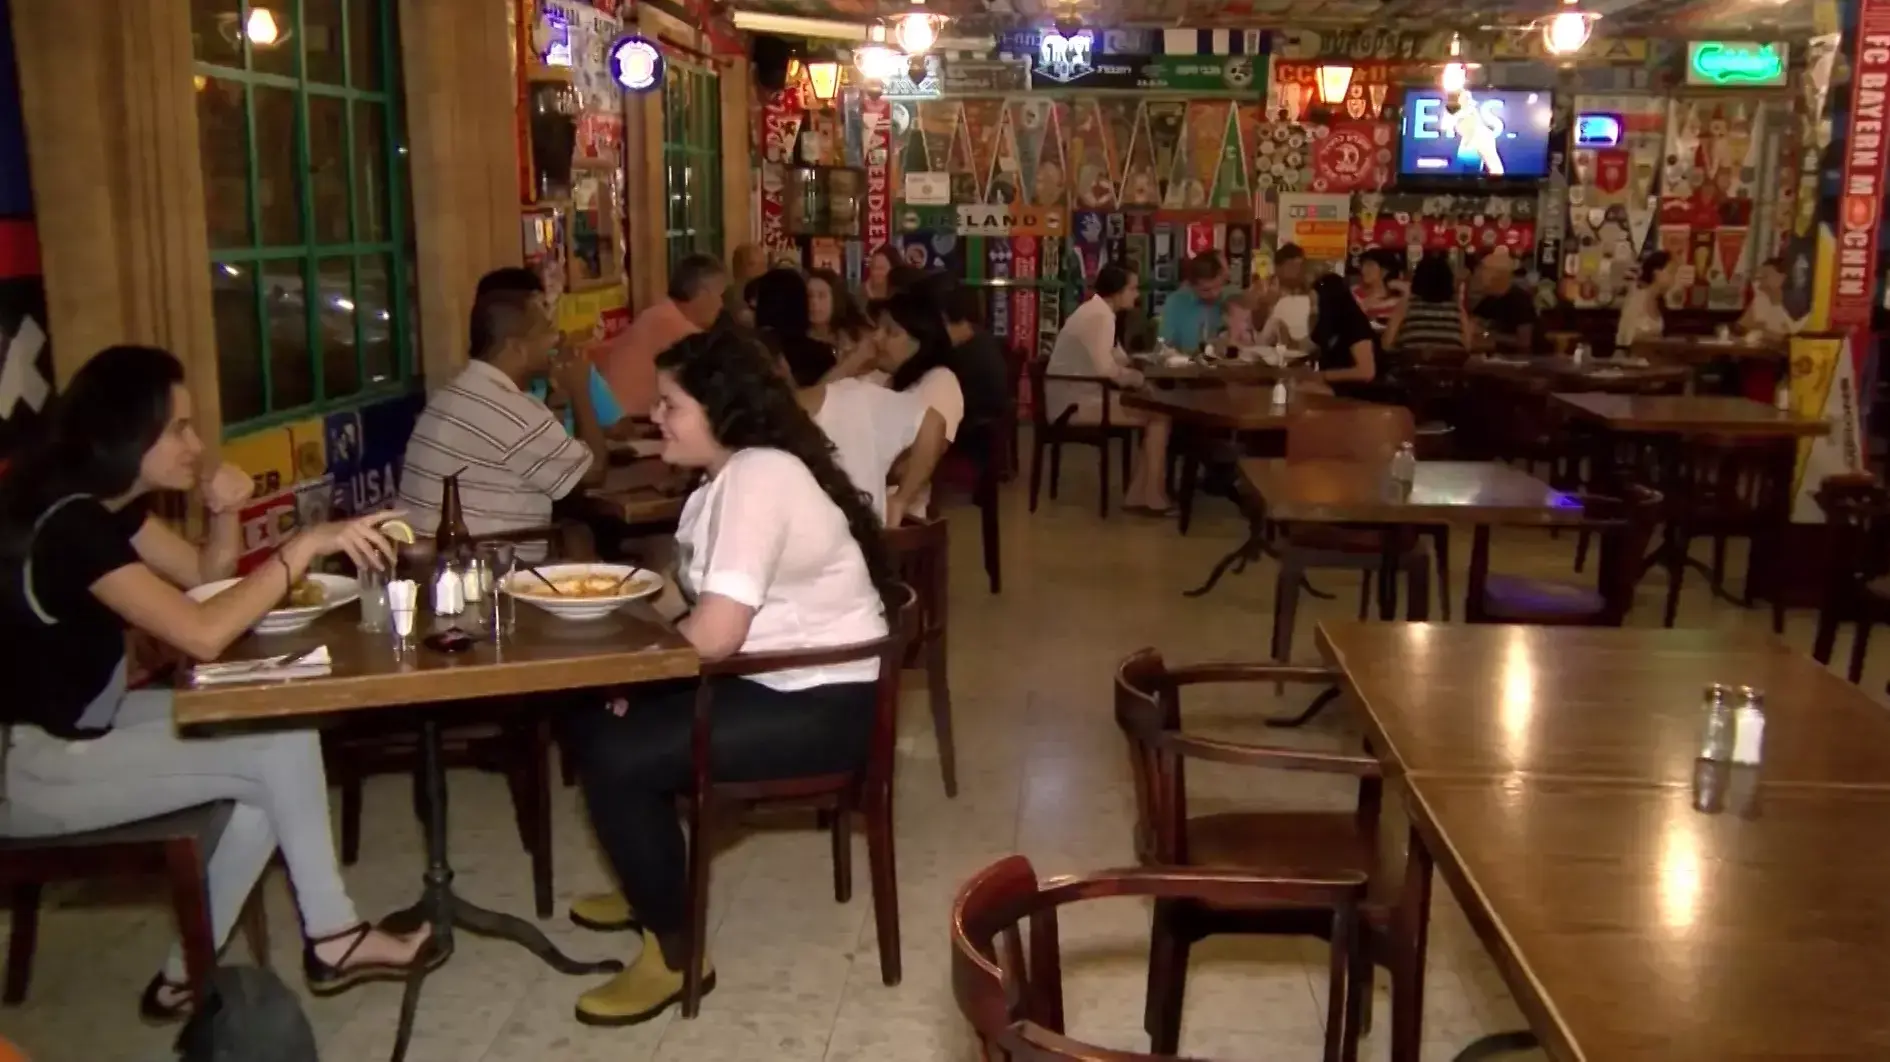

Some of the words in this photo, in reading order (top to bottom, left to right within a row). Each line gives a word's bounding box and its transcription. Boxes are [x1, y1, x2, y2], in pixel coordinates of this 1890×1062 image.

[1863, 35, 1889, 64] FC
[1853, 73, 1887, 166] BAYERN
[1838, 175, 1875, 295] MCHEN
[351, 461, 395, 510] USA
